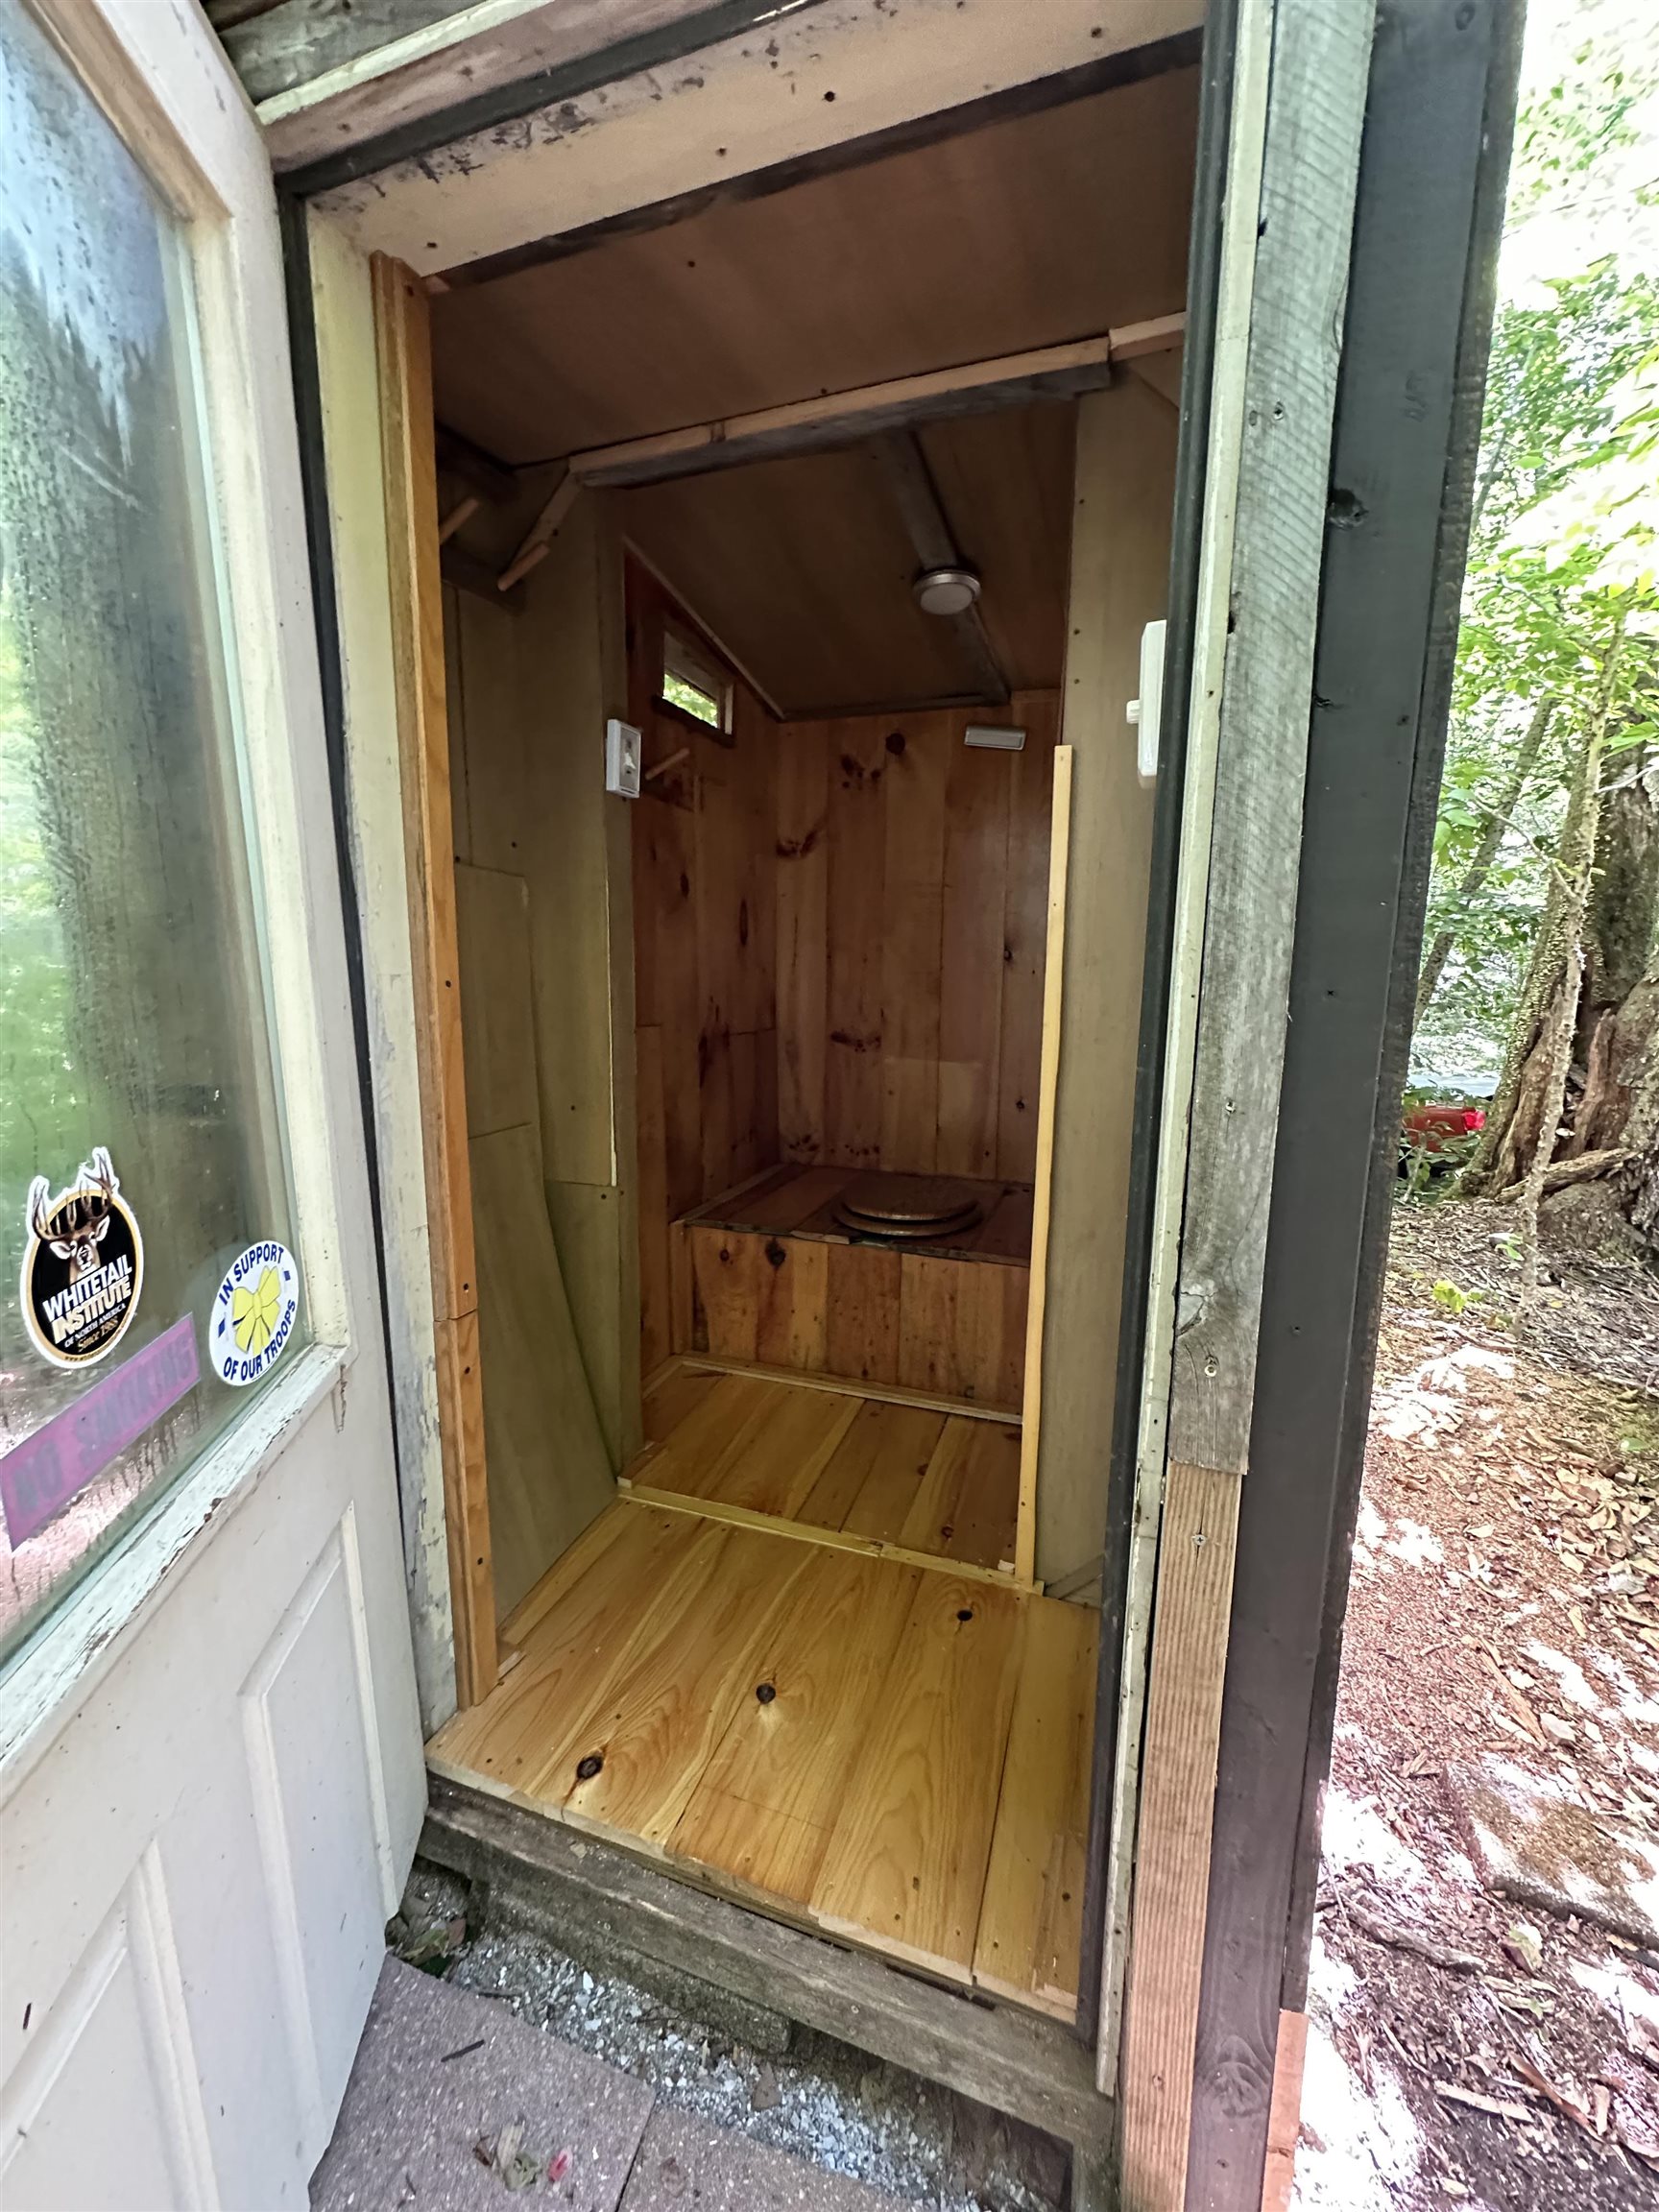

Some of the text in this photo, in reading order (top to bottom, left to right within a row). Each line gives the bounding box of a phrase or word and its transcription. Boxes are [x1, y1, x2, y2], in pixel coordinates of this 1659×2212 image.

[42, 1254, 132, 1323] WHITETAIL
[219, 1243, 284, 1306] IN SUPPORT
[50, 1275, 132, 1344] INSTITUTE
[64, 1335, 74, 1348] OF
[99, 1303, 127, 1325] AMERICA
[224, 1299, 296, 1381] OF OUR TROOPS
